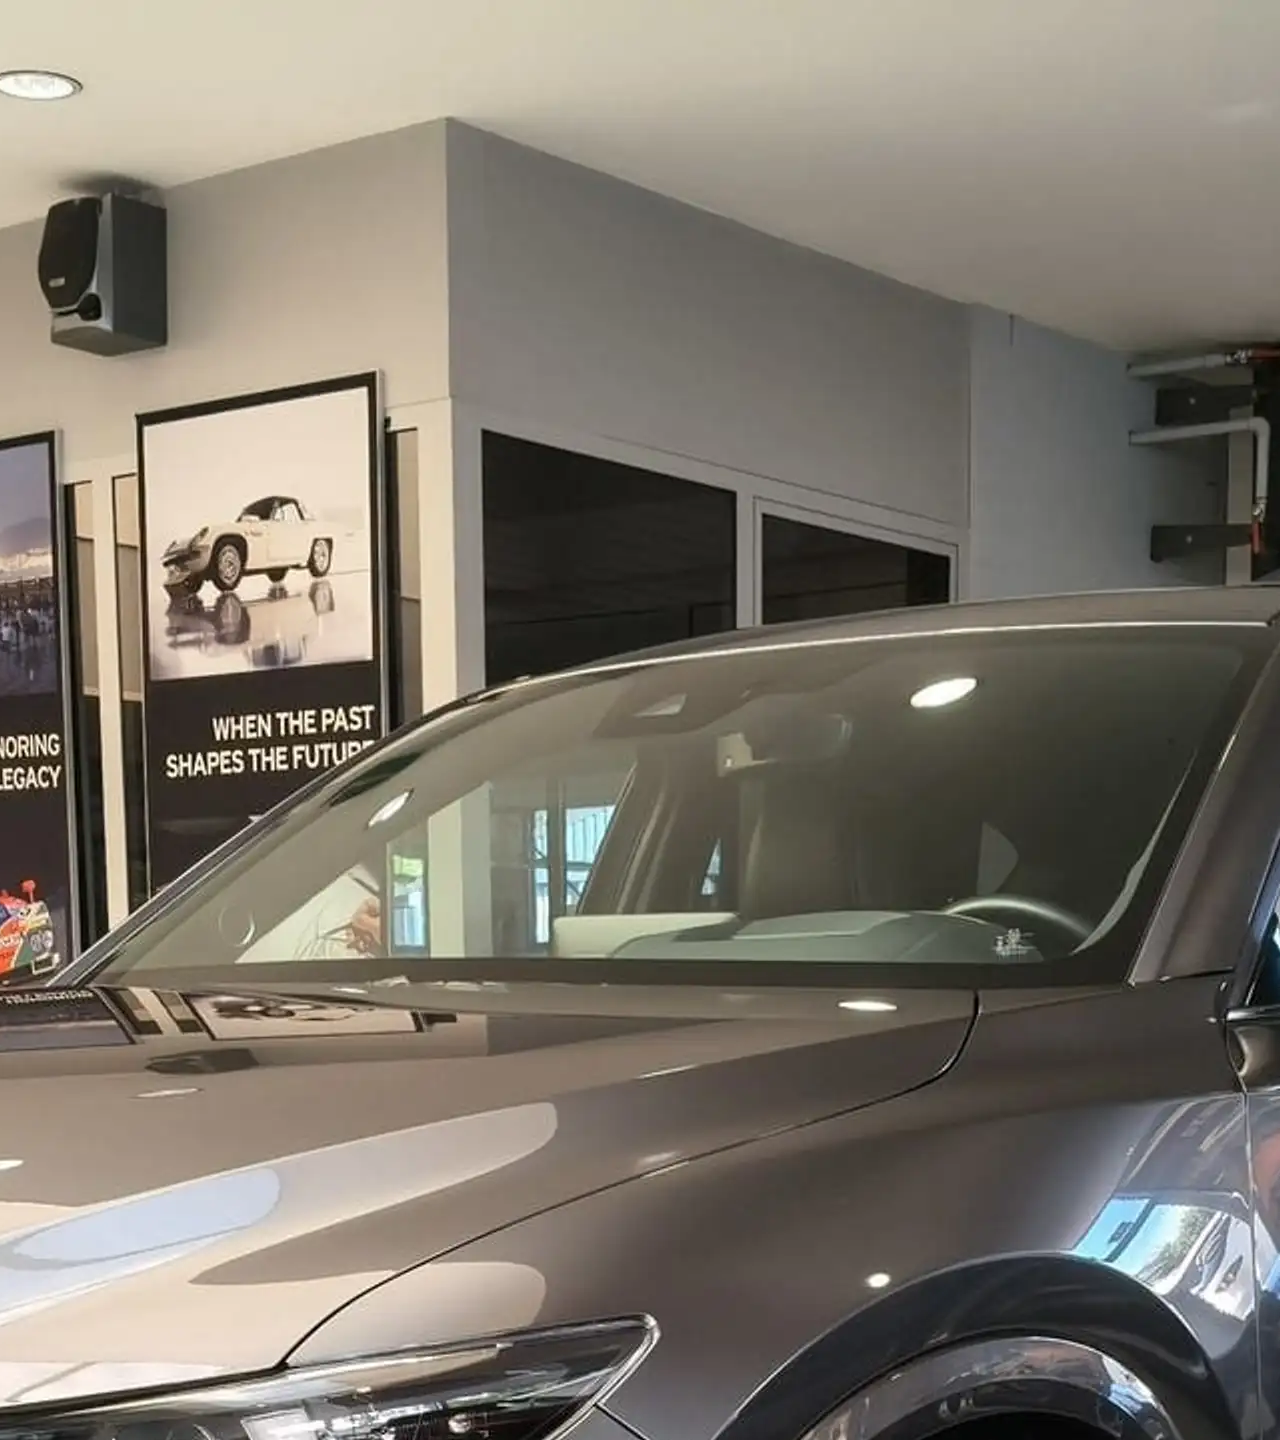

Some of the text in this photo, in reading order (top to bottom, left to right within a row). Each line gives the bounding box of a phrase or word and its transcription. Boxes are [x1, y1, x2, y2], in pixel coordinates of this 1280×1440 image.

[212, 704, 375, 741] WHEN THE PAST
[166, 749, 245, 778] SHAPES
[248, 744, 289, 772] THE
